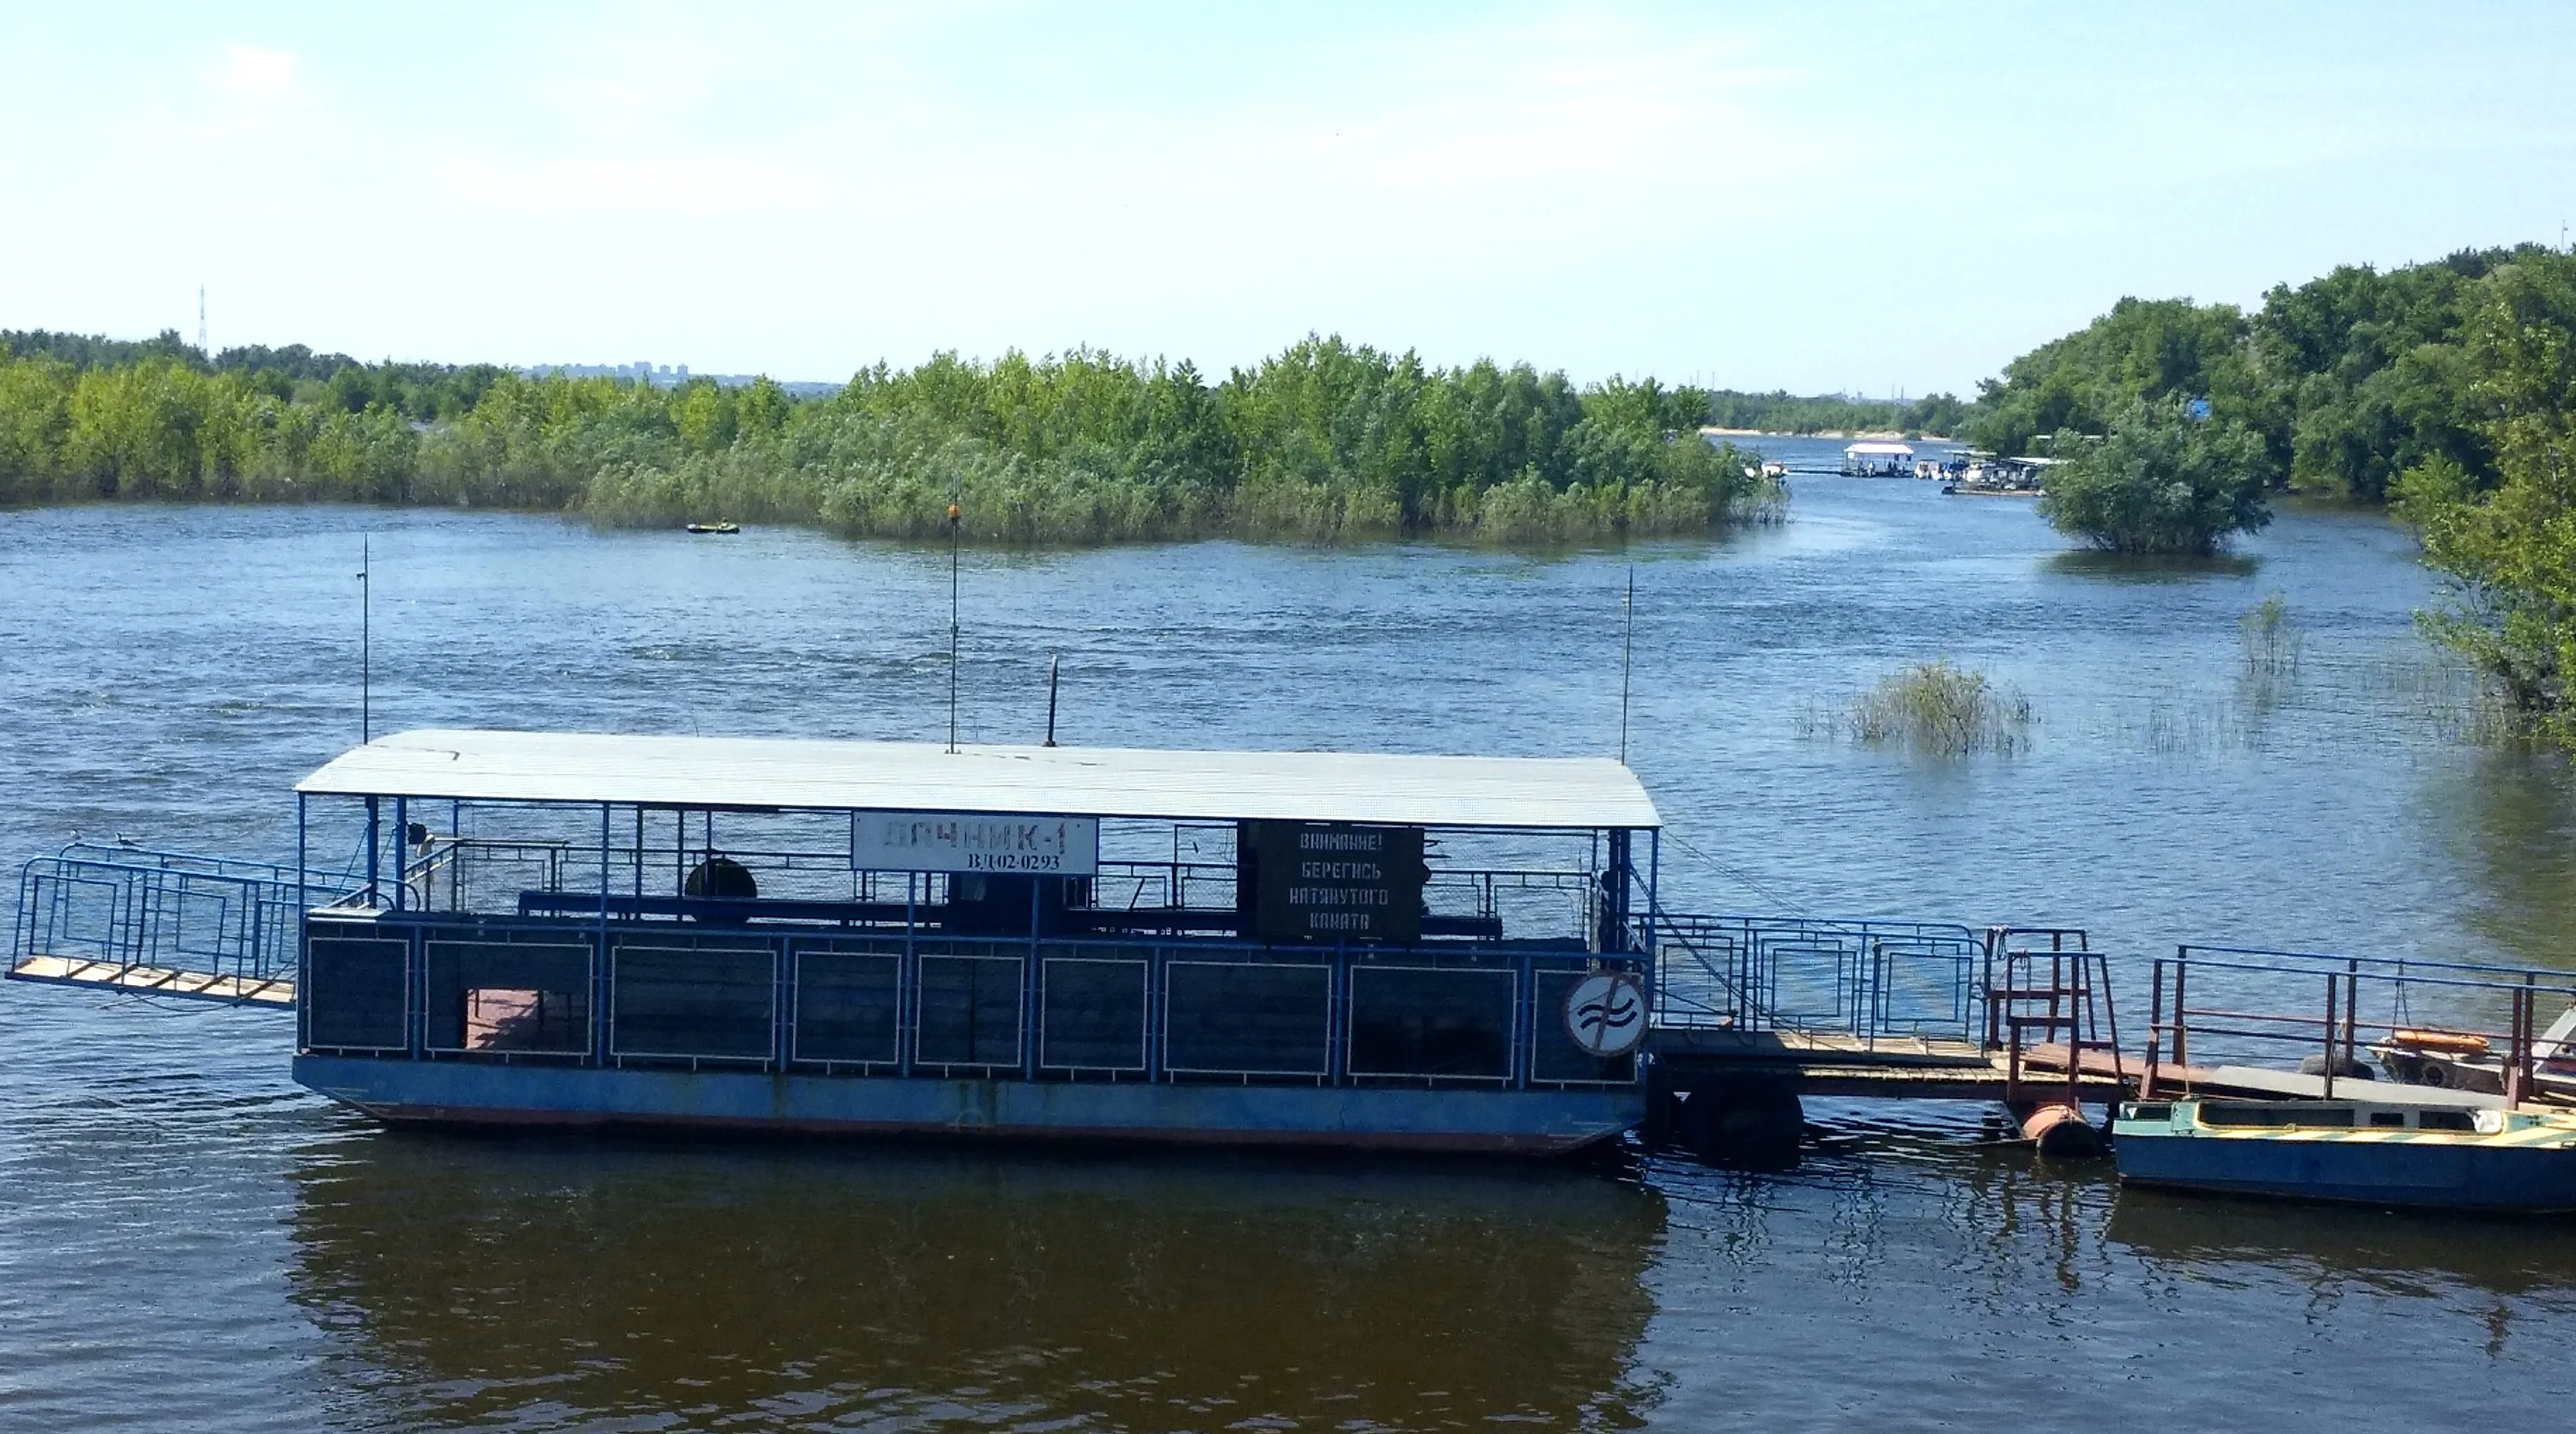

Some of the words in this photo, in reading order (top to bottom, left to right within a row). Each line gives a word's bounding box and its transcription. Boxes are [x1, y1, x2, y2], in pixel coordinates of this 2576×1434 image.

[1300, 833, 1382, 851] ВНИМАНИЕ!
[1302, 862, 1381, 880] БЕРЕГИСЬ
[1289, 887, 1388, 905] НАТЯНУТОГО
[1310, 913, 1370, 930] КАНАТА
